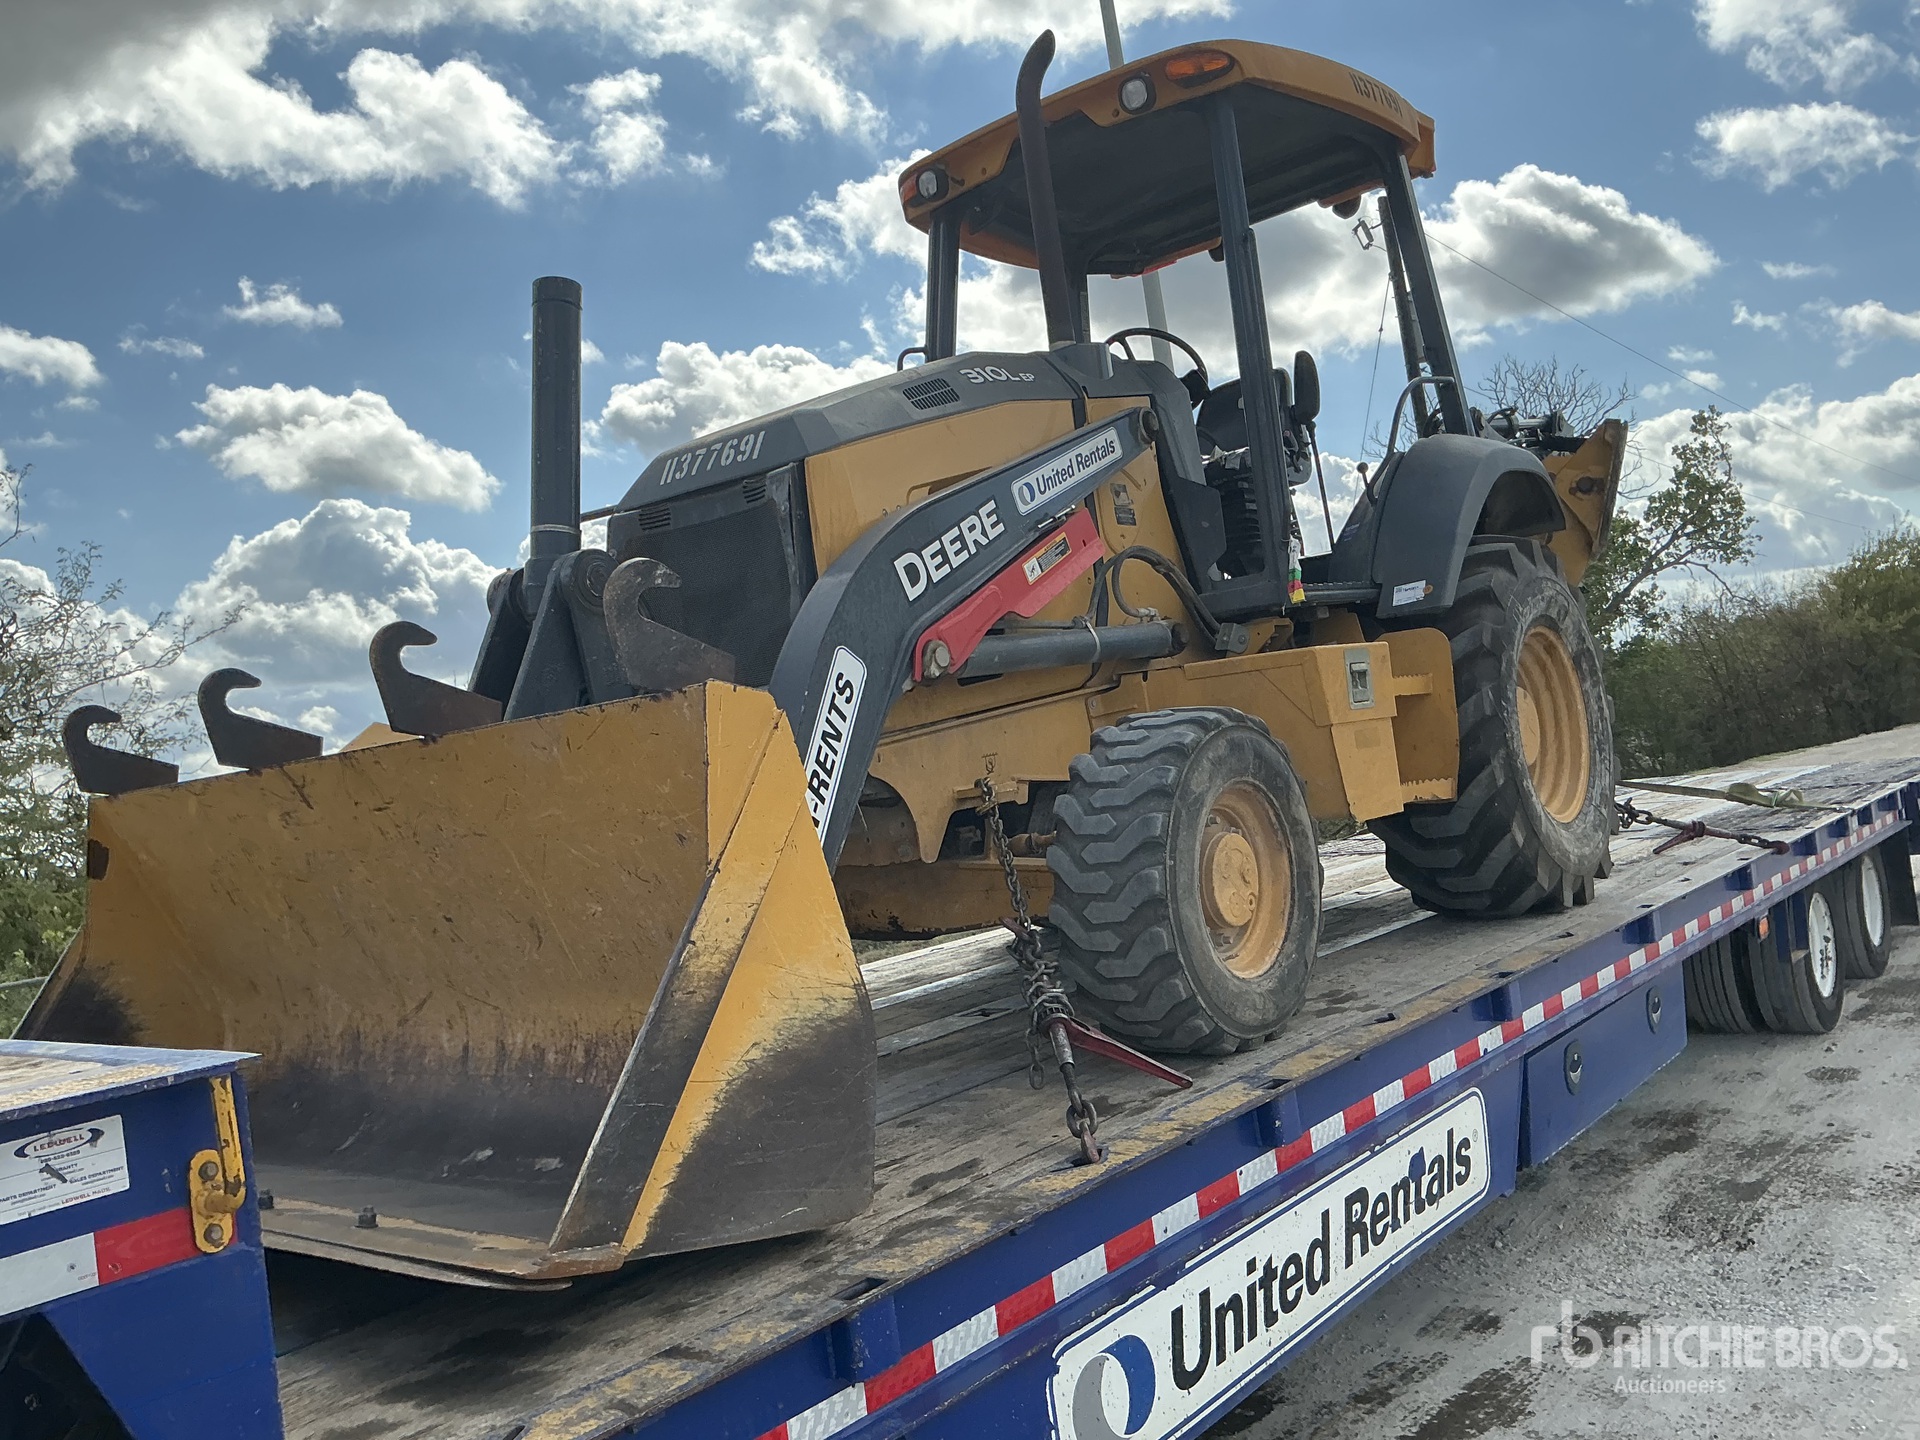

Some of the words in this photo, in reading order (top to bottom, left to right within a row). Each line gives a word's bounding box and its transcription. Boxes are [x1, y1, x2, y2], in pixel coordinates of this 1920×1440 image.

[959, 366, 1021, 384] 310L
[1018, 372, 1036, 382] EP
[659, 430, 766, 486] 11377691
[1036, 458, 1075, 496] United
[1074, 438, 1116, 473] Rentals
[893, 499, 1005, 602] DEERE
[33, 1133, 85, 1152] LEDWELL
[88, 1166, 124, 1179] DEPARTMENT
[18, 1184, 56, 1198] DEPARTMENT
[61, 1192, 91, 1204] LEDWELL
[1170, 1208, 1331, 1393] United
[1343, 1129, 1472, 1270] Rentals
